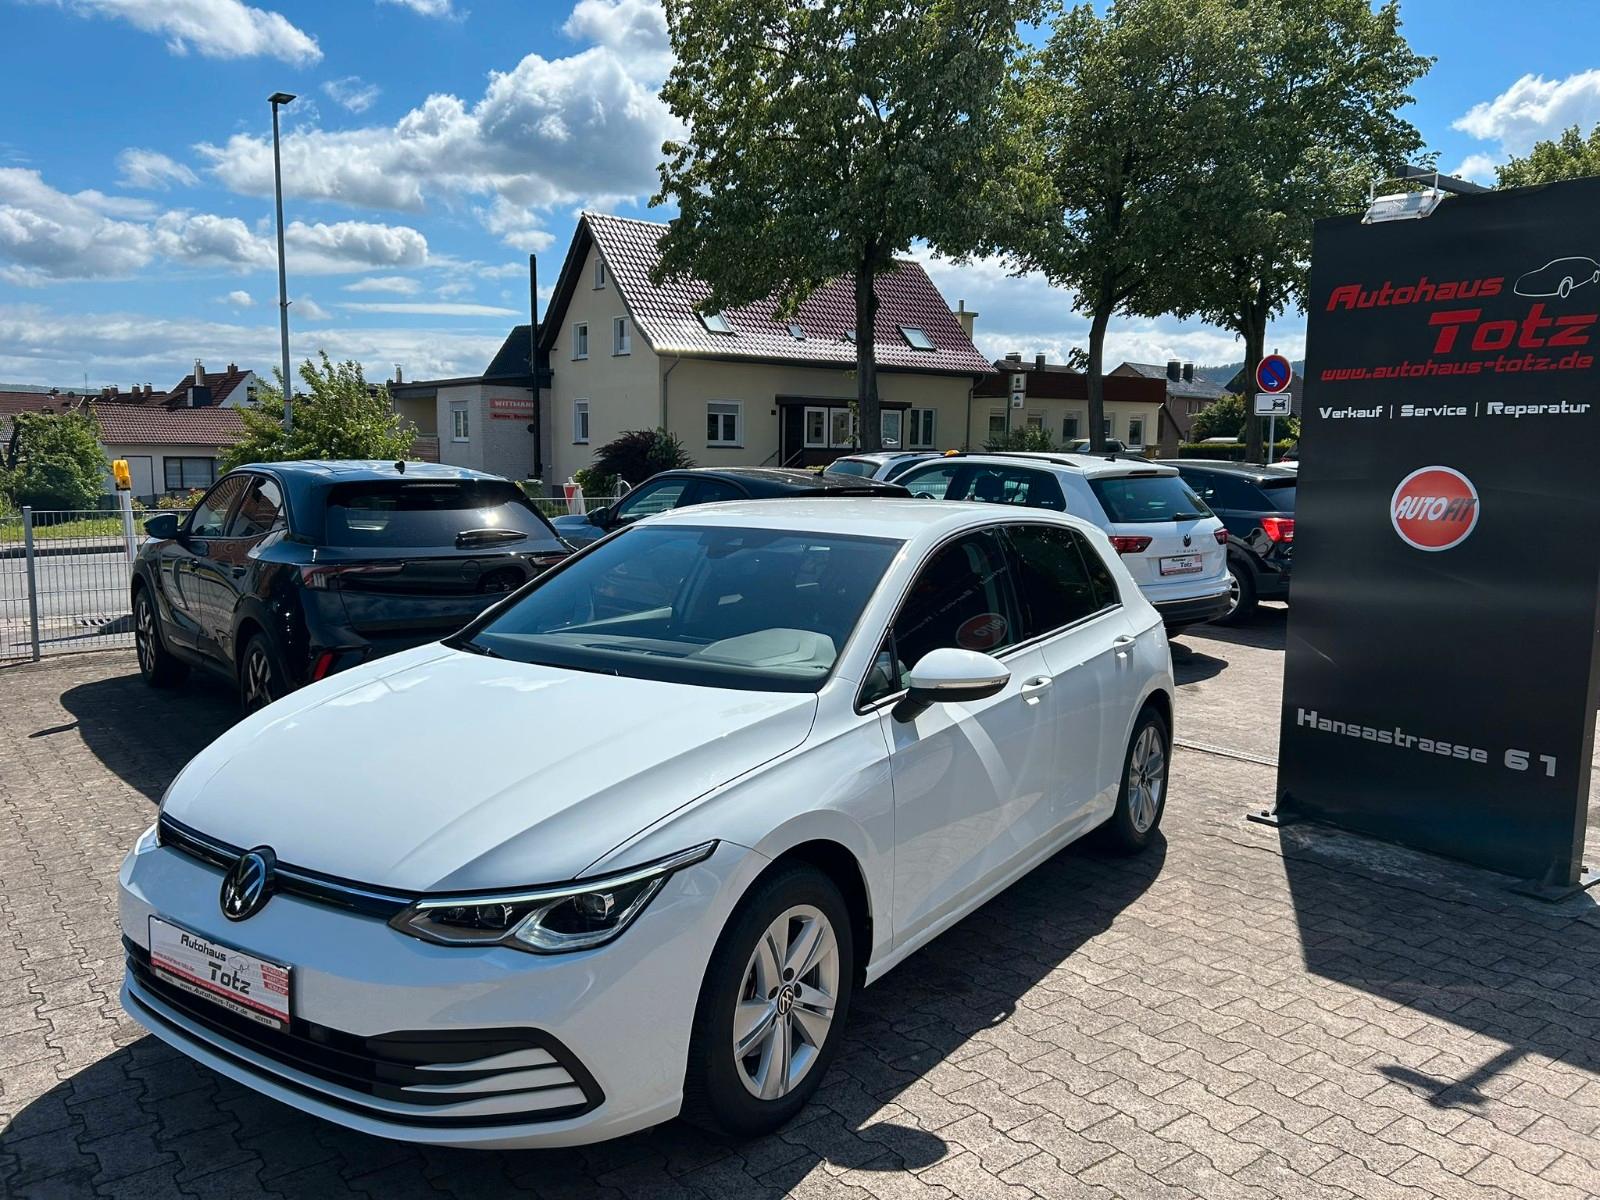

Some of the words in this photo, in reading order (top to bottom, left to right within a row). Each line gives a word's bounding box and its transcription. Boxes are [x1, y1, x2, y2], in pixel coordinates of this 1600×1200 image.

[1326, 276, 1505, 312] Autohaus
[1428, 303, 1599, 355] Totz
[1321, 351, 1594, 382] www.autohaus-totz.de
[495, 400, 534, 409] WITTMAN
[1319, 405, 1384, 419] Verkauf
[1400, 404, 1468, 418] Service
[1486, 400, 1592, 418] Reparatur
[1297, 707, 1489, 764] Hansastrasse
[180, 933, 227, 962] Autohaus
[208, 960, 252, 995] Totz
